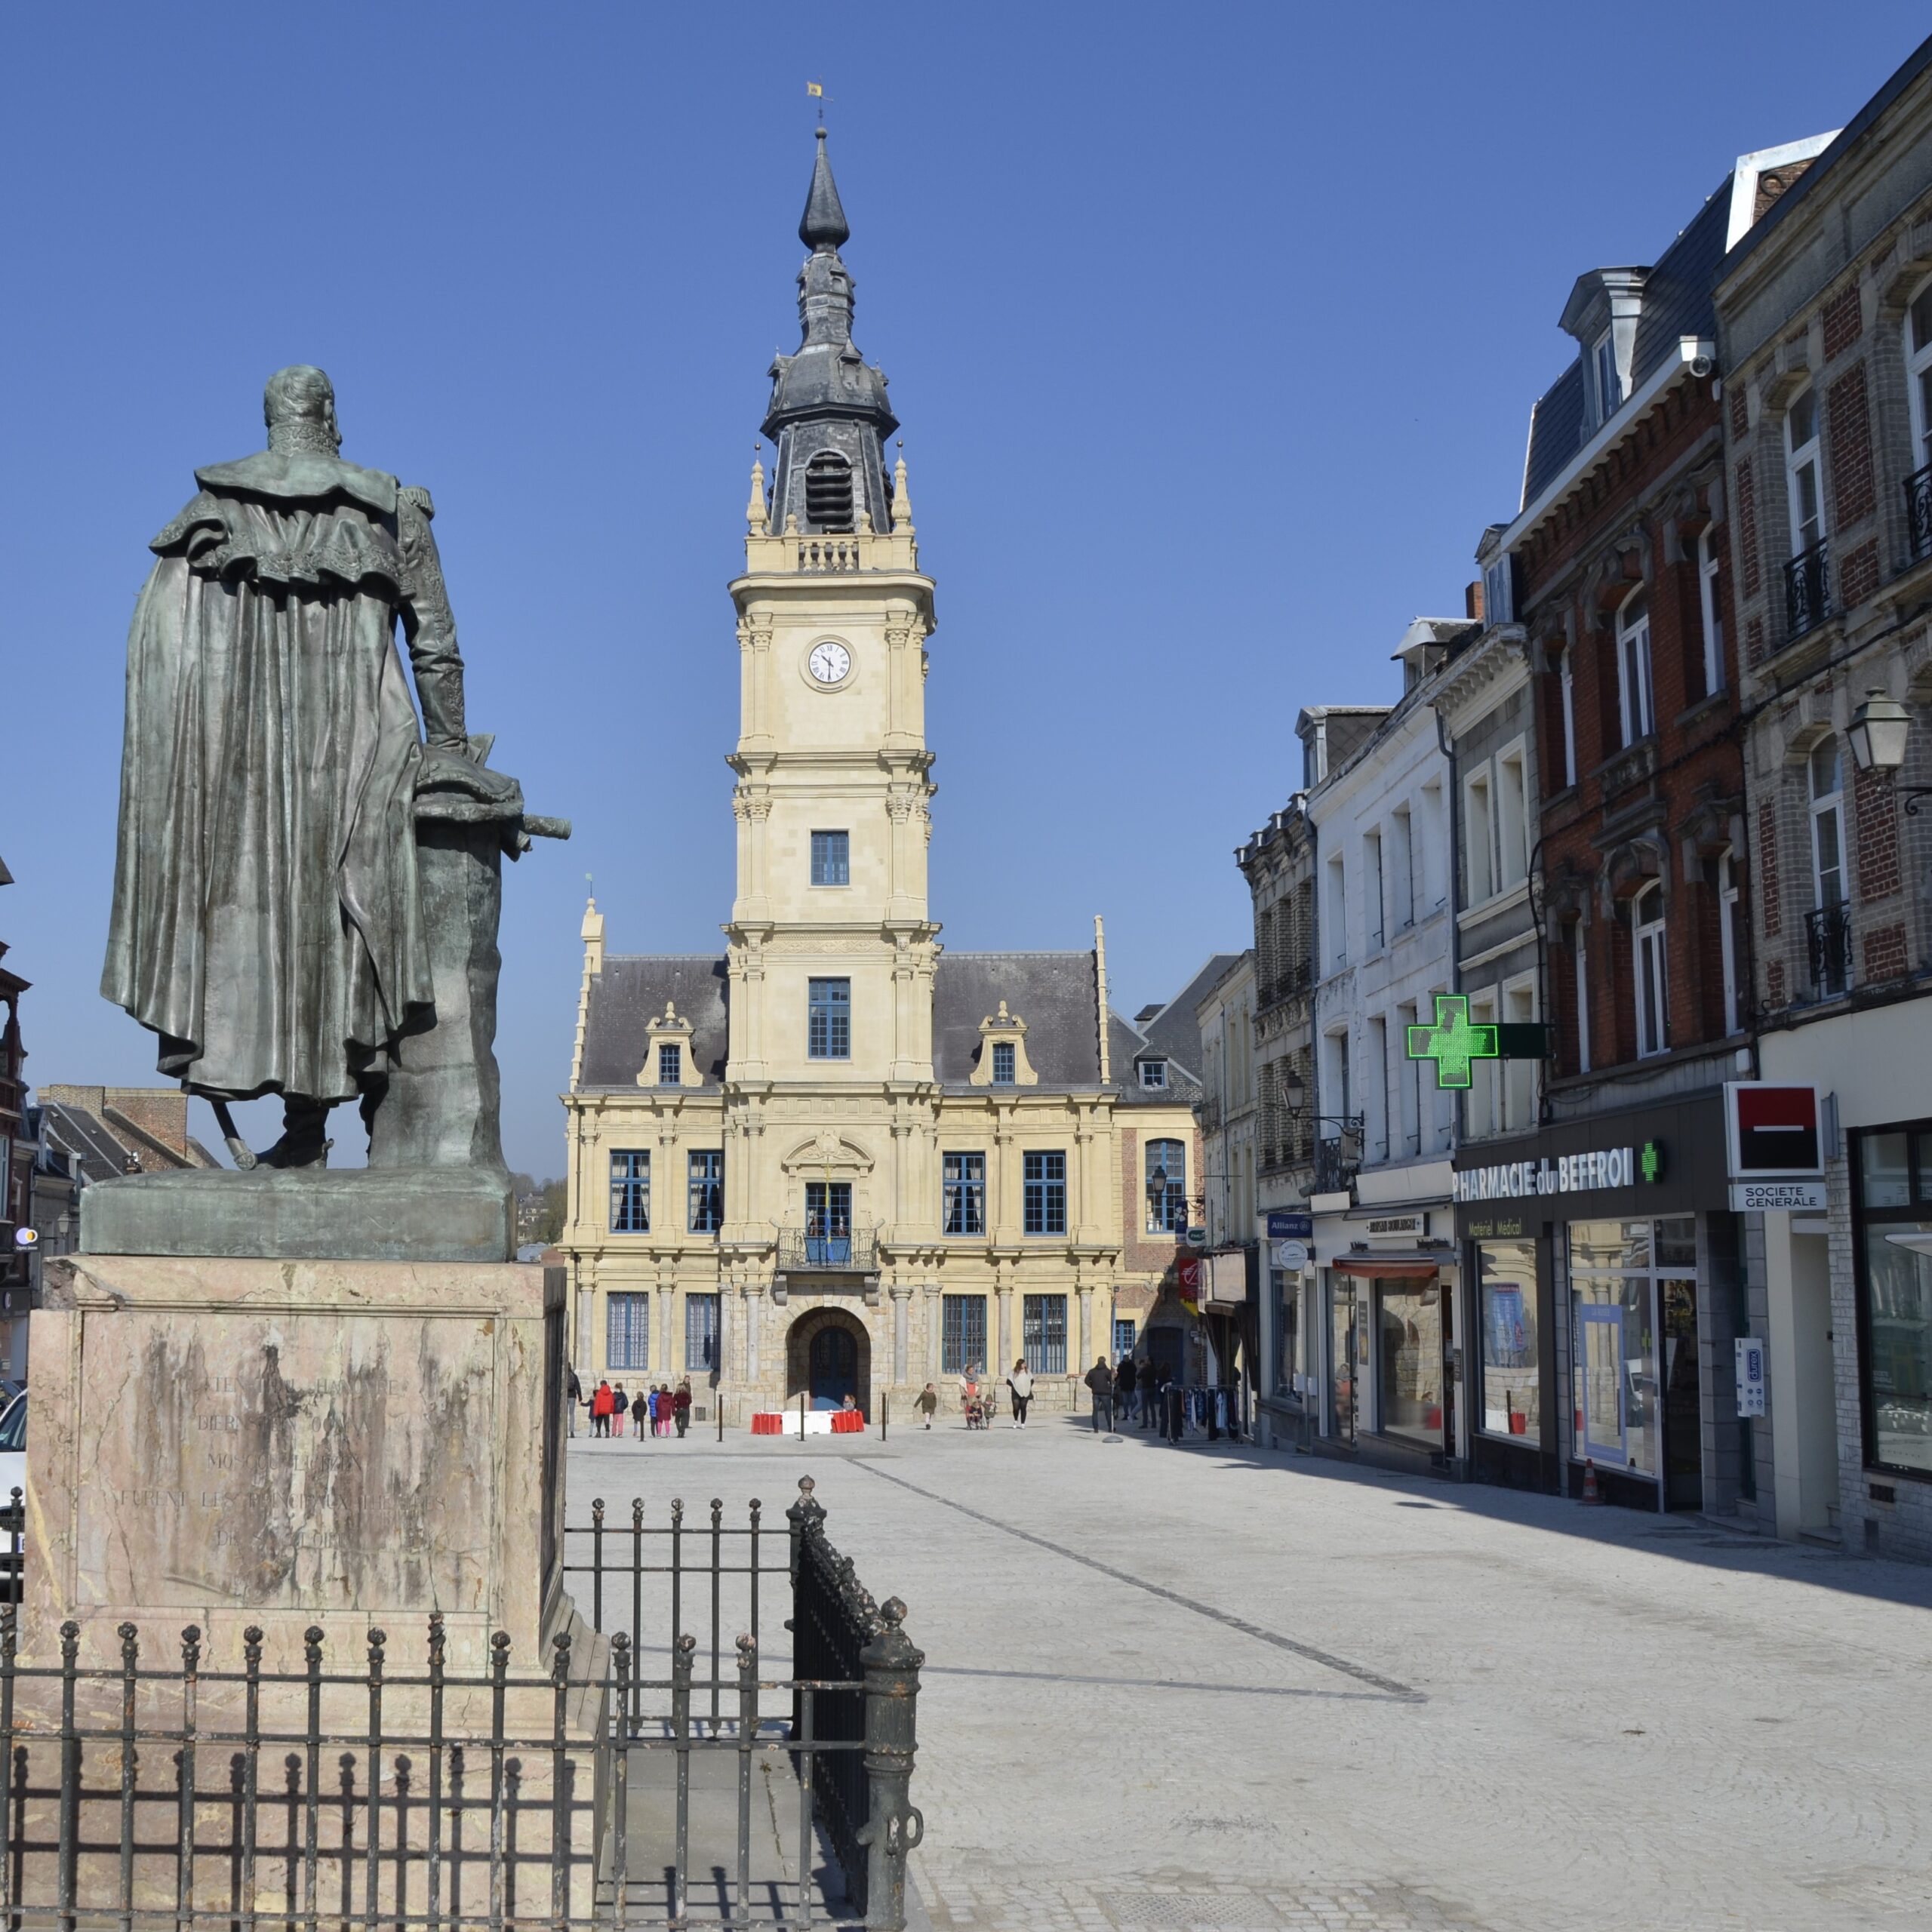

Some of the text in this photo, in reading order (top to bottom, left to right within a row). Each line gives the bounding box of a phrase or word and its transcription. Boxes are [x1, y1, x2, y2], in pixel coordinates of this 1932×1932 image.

[1452, 1147, 1634, 1201] PHARMACIE du BEFFROI
[1745, 1186, 1804, 1197] SOCIETE
[1745, 1197, 1817, 1208] GENERALE
[1271, 1221, 1299, 1230] Allianz
[1469, 1218, 1522, 1237] Matériel Médical
[1749, 1351, 1758, 1380] durex
[121, 1490, 189, 1506] FURENT
